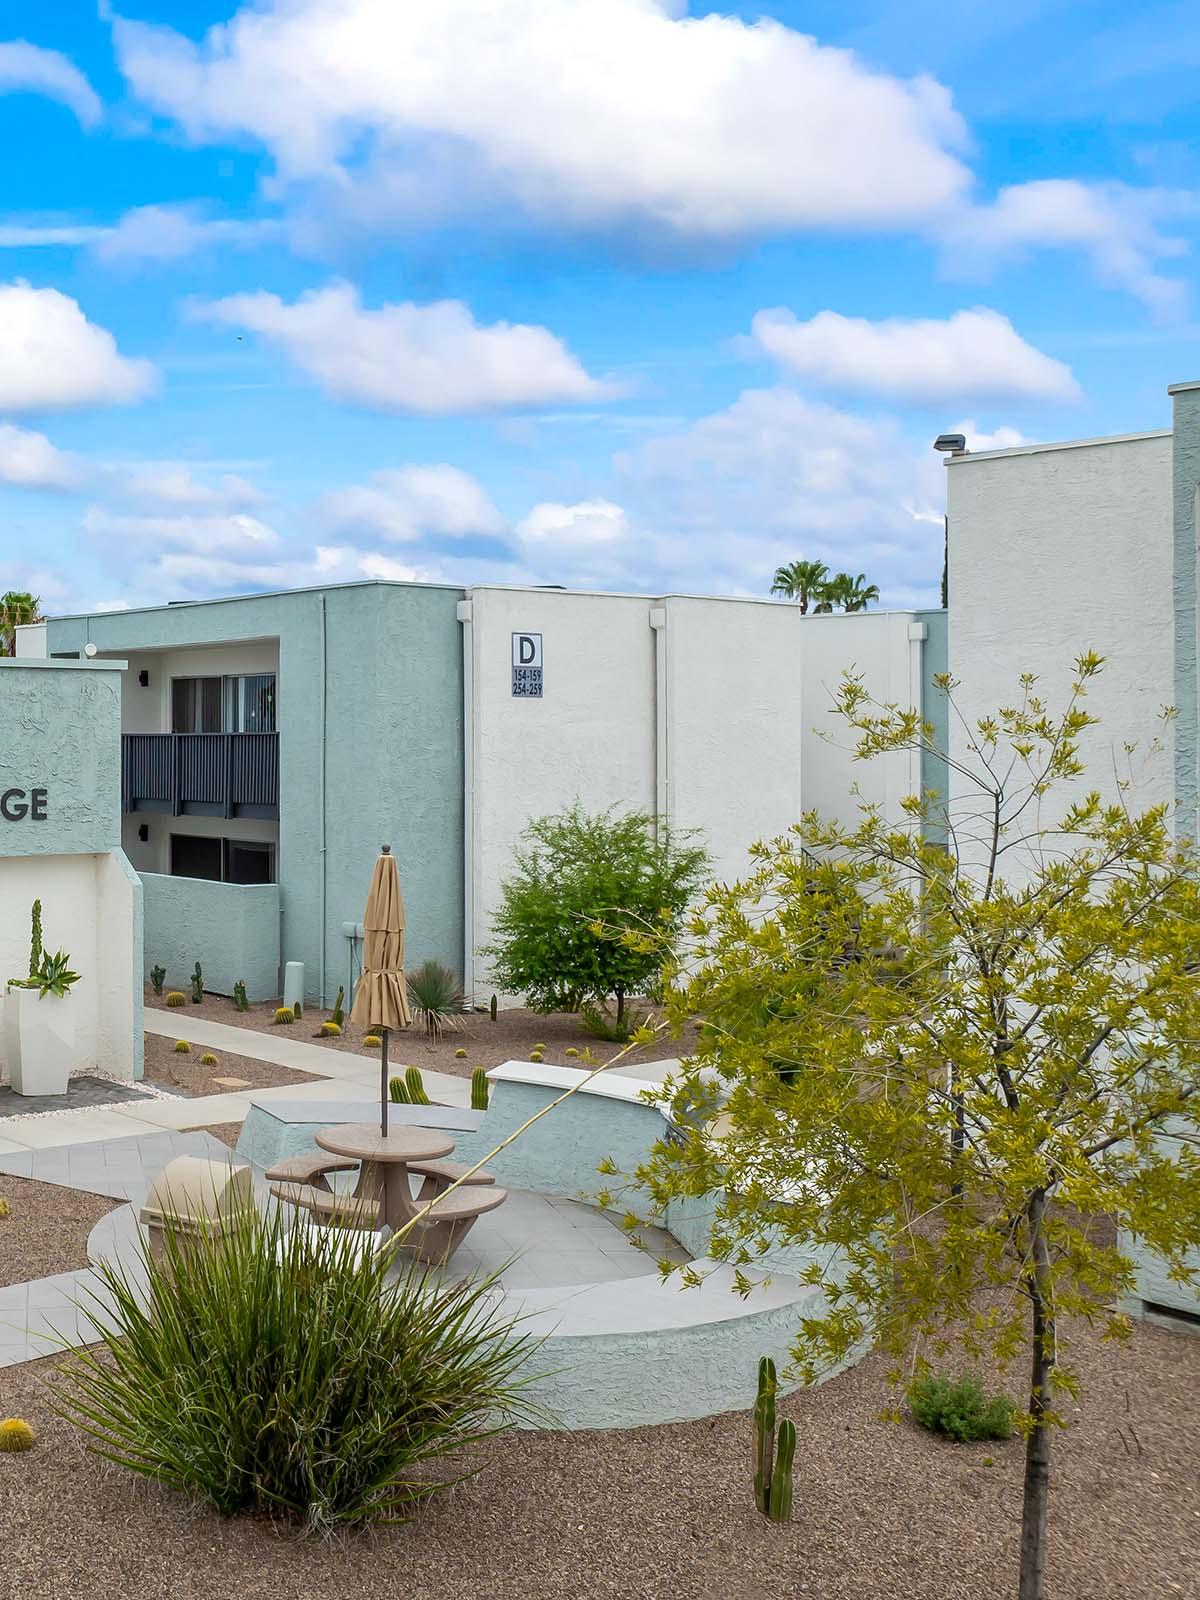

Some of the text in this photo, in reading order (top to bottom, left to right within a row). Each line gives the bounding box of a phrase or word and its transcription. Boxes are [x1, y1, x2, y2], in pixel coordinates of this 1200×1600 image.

[520, 636, 536, 664] D
[514, 669, 542, 681] 154-159
[513, 682, 543, 695] 254-259
